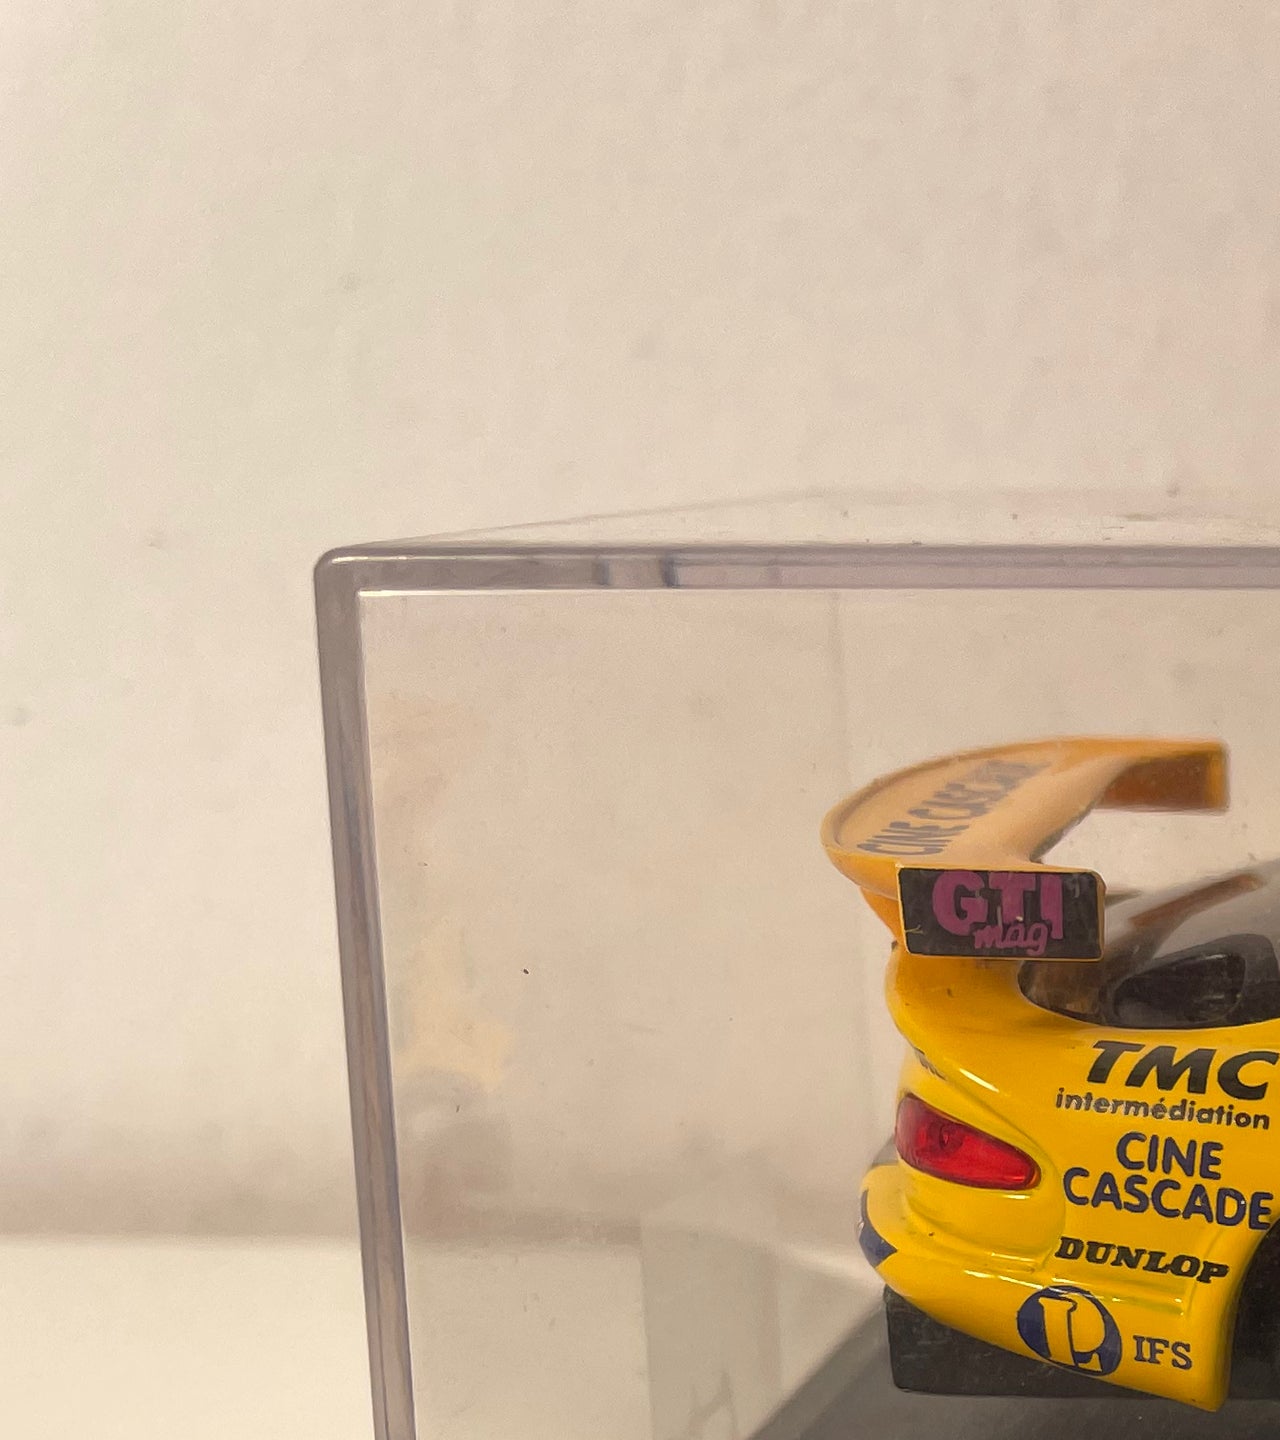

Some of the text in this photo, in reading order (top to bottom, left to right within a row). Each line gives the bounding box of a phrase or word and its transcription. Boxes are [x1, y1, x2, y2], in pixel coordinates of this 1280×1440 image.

[932, 870, 1064, 940] GTI
[972, 921, 1049, 956] mag
[1087, 1040, 1280, 1100] TMC
[1056, 1087, 1270, 1130] intermédiation
[1116, 1131, 1224, 1180] CINE
[1063, 1168, 1274, 1231] CASCADE
[1055, 1236, 1230, 1283] DUNLOP
[1133, 1335, 1193, 1370] IFS
